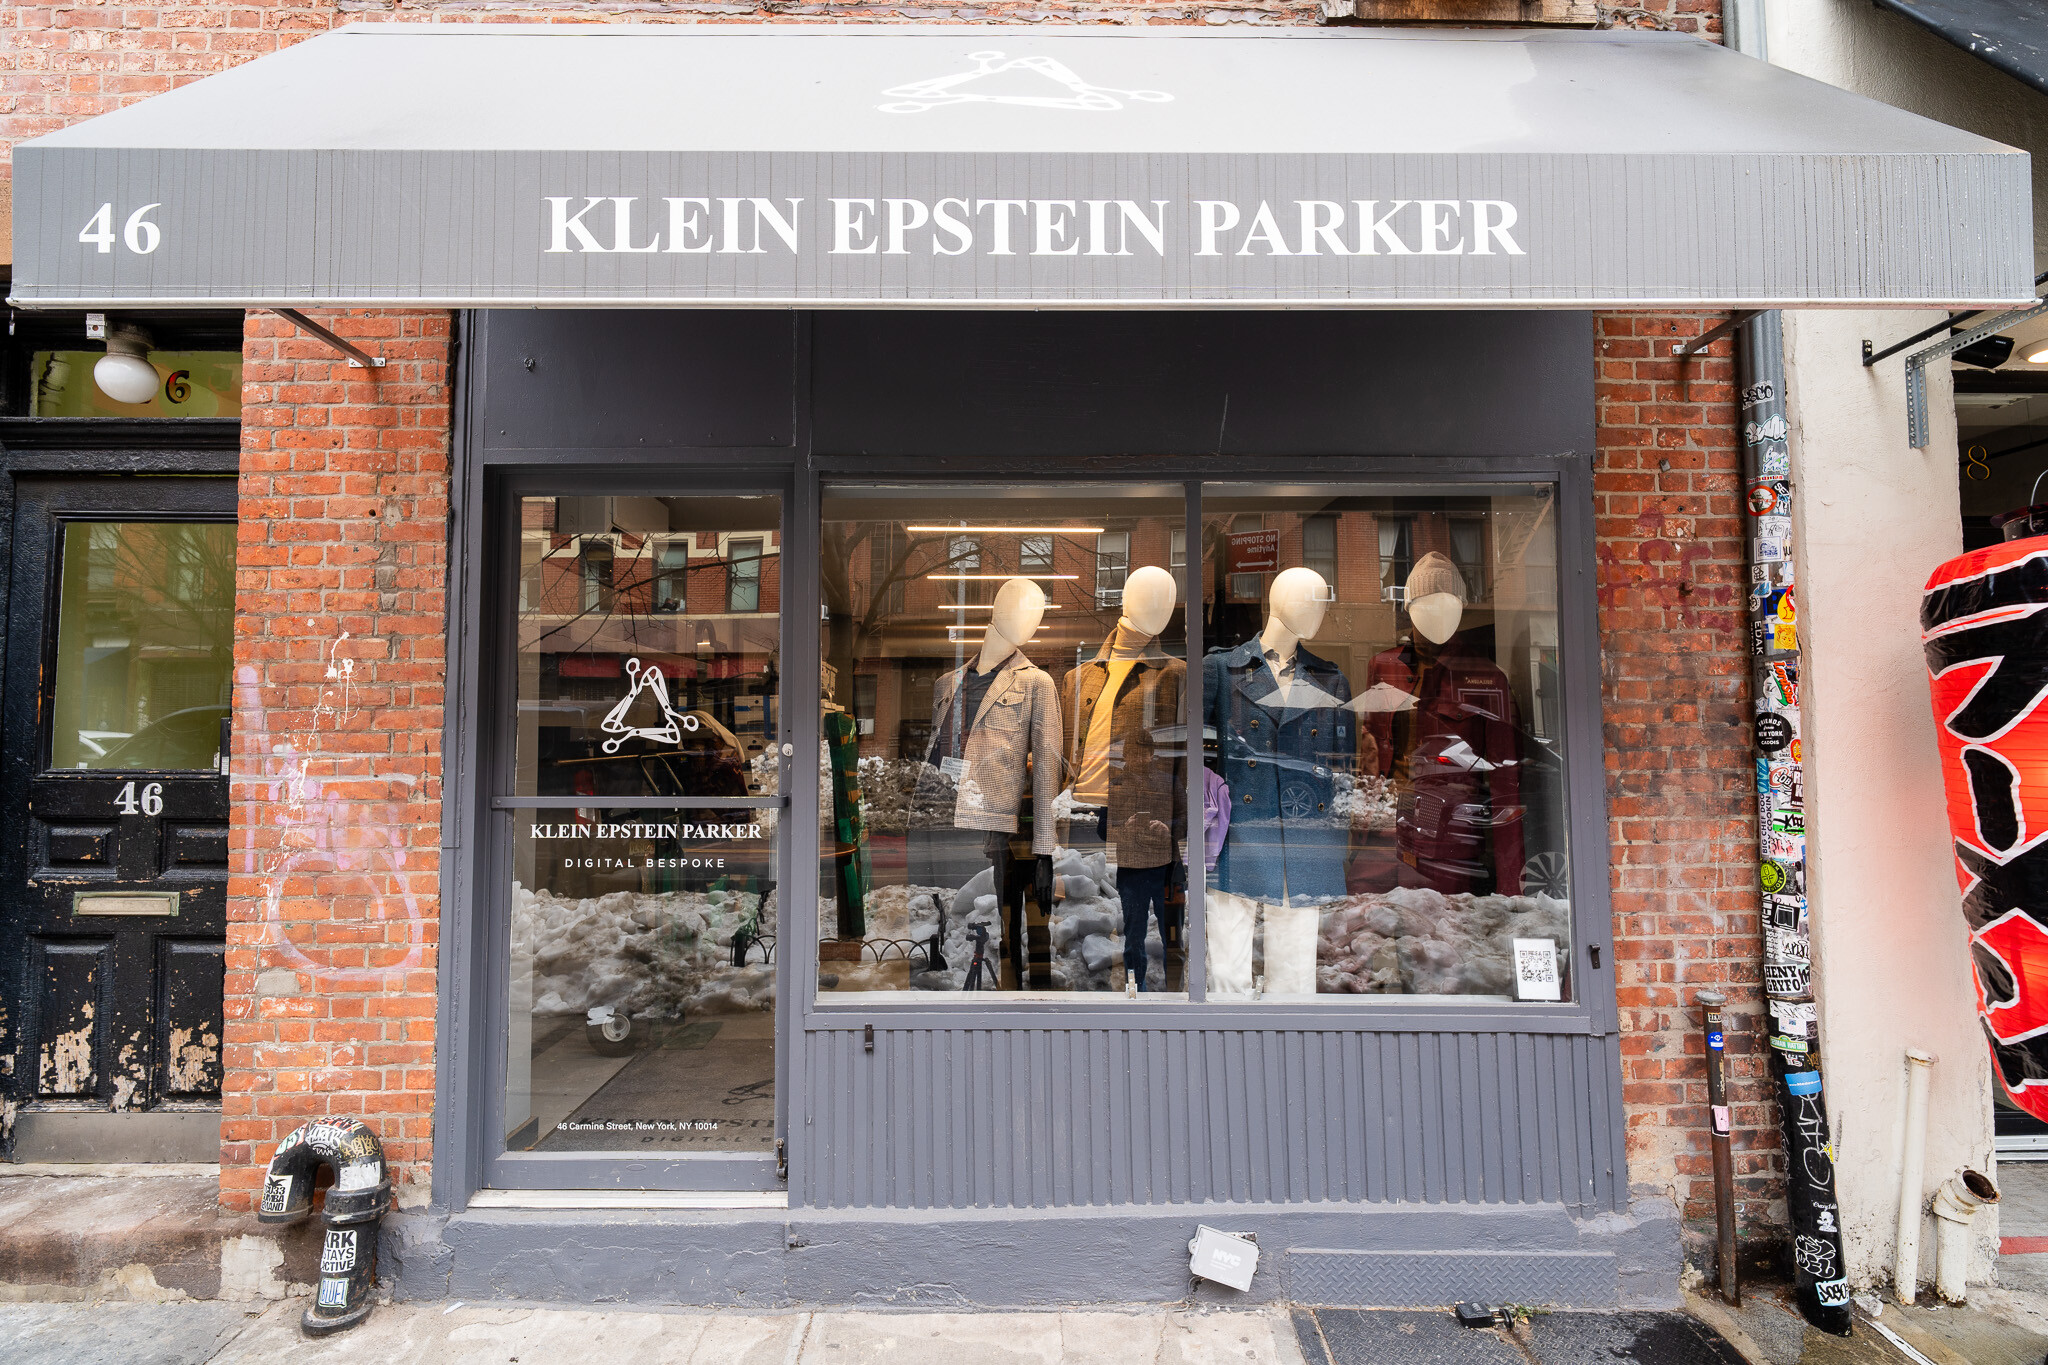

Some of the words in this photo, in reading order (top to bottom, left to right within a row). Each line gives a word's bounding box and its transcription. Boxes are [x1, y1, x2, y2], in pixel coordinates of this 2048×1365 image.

[78, 202, 161, 255] 46
[544, 196, 804, 255] KLEIN
[827, 197, 1170, 256] EPSTEIN
[1193, 199, 1527, 256] PARKER
[113, 781, 163, 816] 46
[1765, 795, 1773, 831] COOKIN
[530, 823, 592, 839] KLEIN
[596, 823, 678, 839] EPSTEIN
[682, 823, 762, 839] PARKER
[564, 858, 635, 868] DIGITAL
[646, 858, 725, 868] BESPOKE
[557, 1122, 568, 1131] 46
[569, 1122, 605, 1131] Carmine
[606, 1122, 633, 1132] Street,
[635, 1122, 654, 1131] New
[656, 1122, 676, 1132] York,
[679, 1122, 692, 1131] NY
[694, 1122, 718, 1131] 10014
